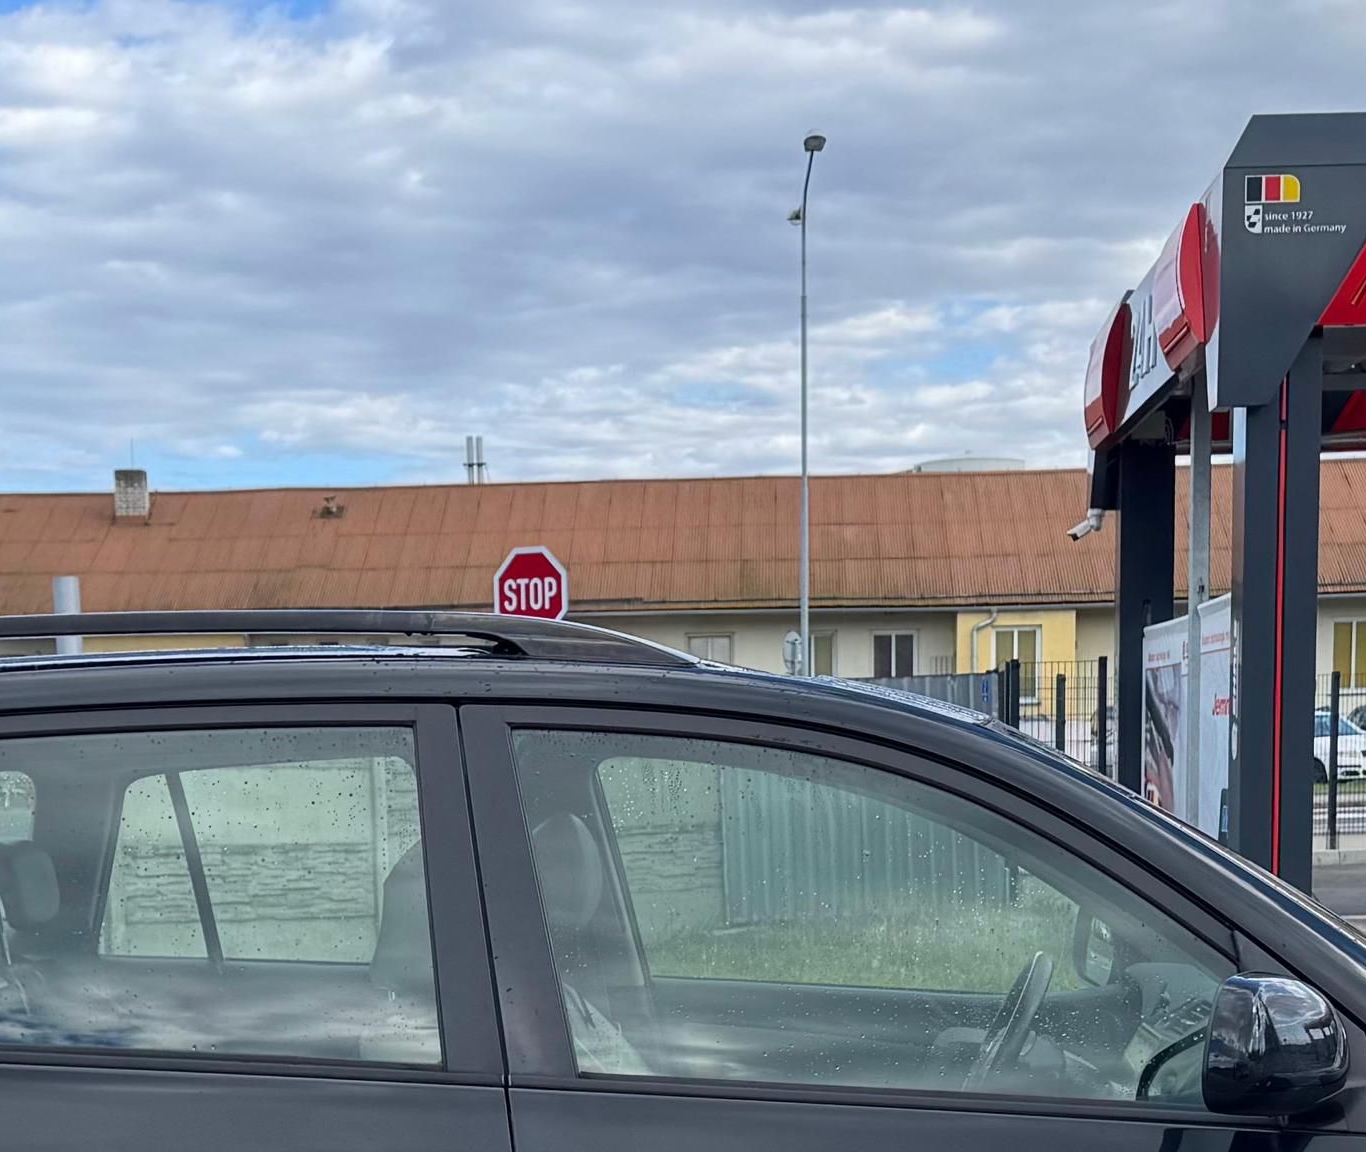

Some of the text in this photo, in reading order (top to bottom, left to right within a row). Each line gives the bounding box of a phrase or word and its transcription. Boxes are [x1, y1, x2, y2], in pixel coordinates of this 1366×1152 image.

[1264, 210, 1314, 221] since 1927
[1264, 223, 1347, 234] made in Germany
[503, 576, 558, 612] STOP
